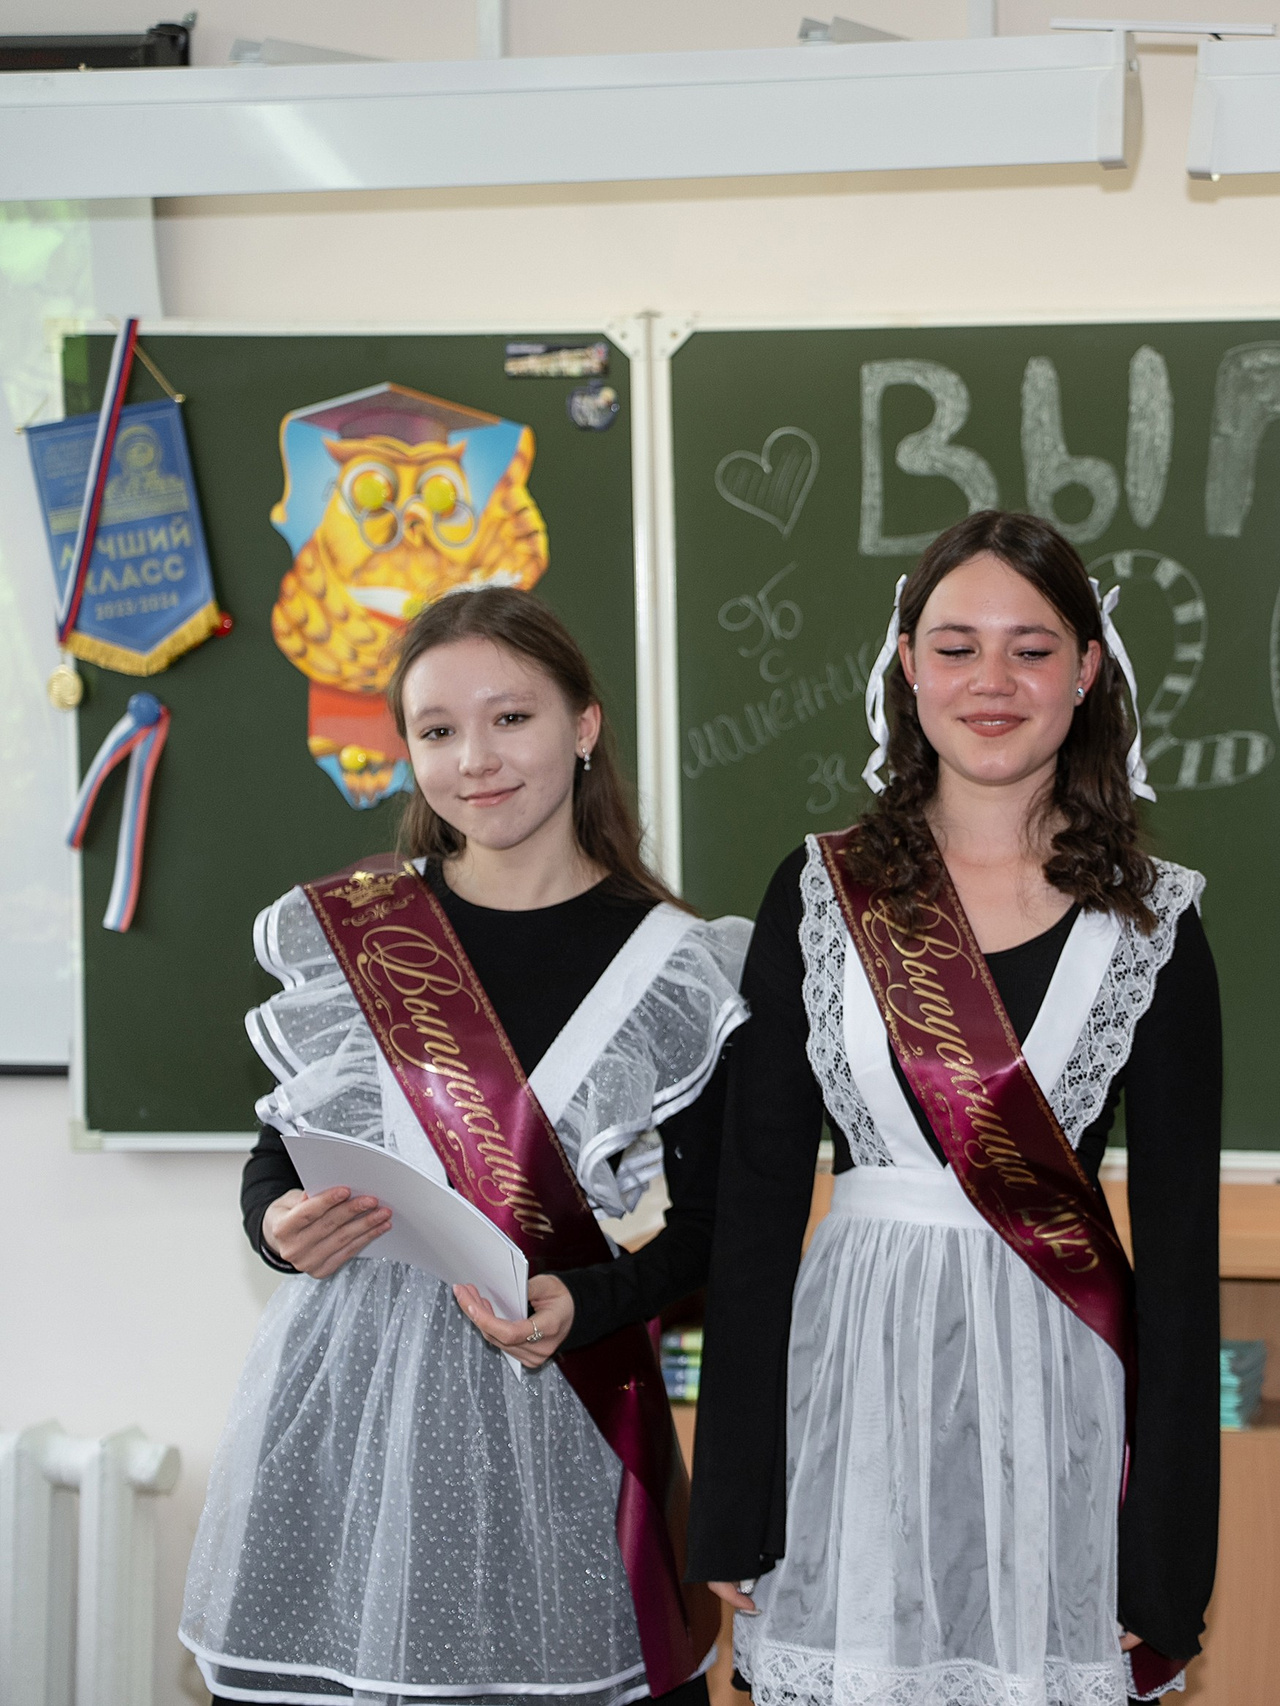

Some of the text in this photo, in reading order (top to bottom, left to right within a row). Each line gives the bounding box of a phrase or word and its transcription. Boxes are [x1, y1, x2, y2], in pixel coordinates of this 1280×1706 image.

[59, 516, 191, 570] ЛЧШИЙ
[362, 924, 555, 1240] Выпускница
[868, 890, 1038, 1191] Выпускница
